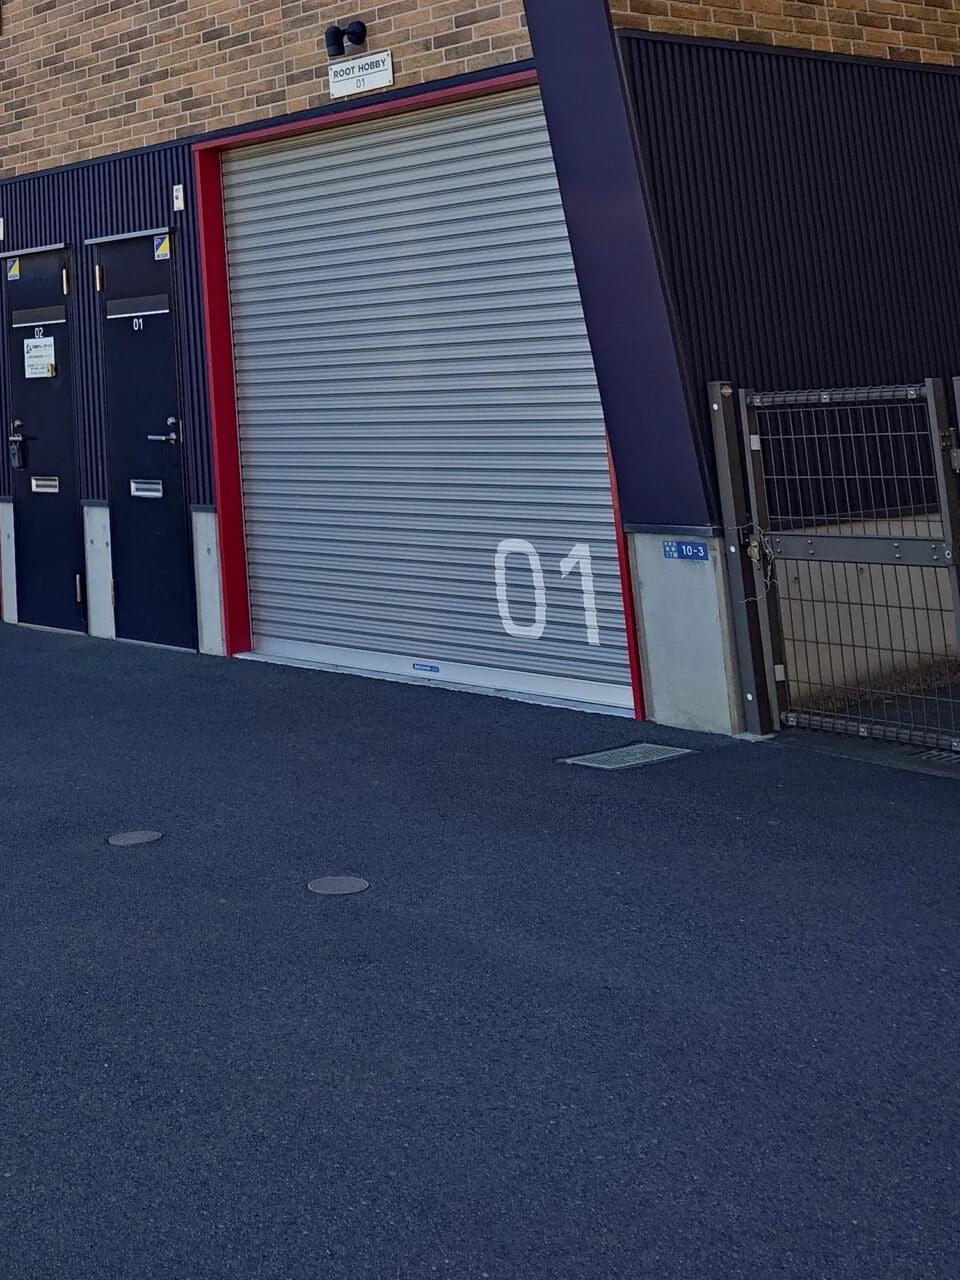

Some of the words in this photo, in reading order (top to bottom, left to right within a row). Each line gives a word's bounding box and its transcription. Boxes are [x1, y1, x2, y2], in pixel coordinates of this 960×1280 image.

[333, 66, 355, 79] ROOT
[358, 58, 387, 73] HOBBY
[356, 78, 366, 89] 01
[133, 317, 143, 331] 01
[34, 327, 44, 339] 02
[681, 545, 705, 557] 10-3
[494, 538, 601, 647] 01
